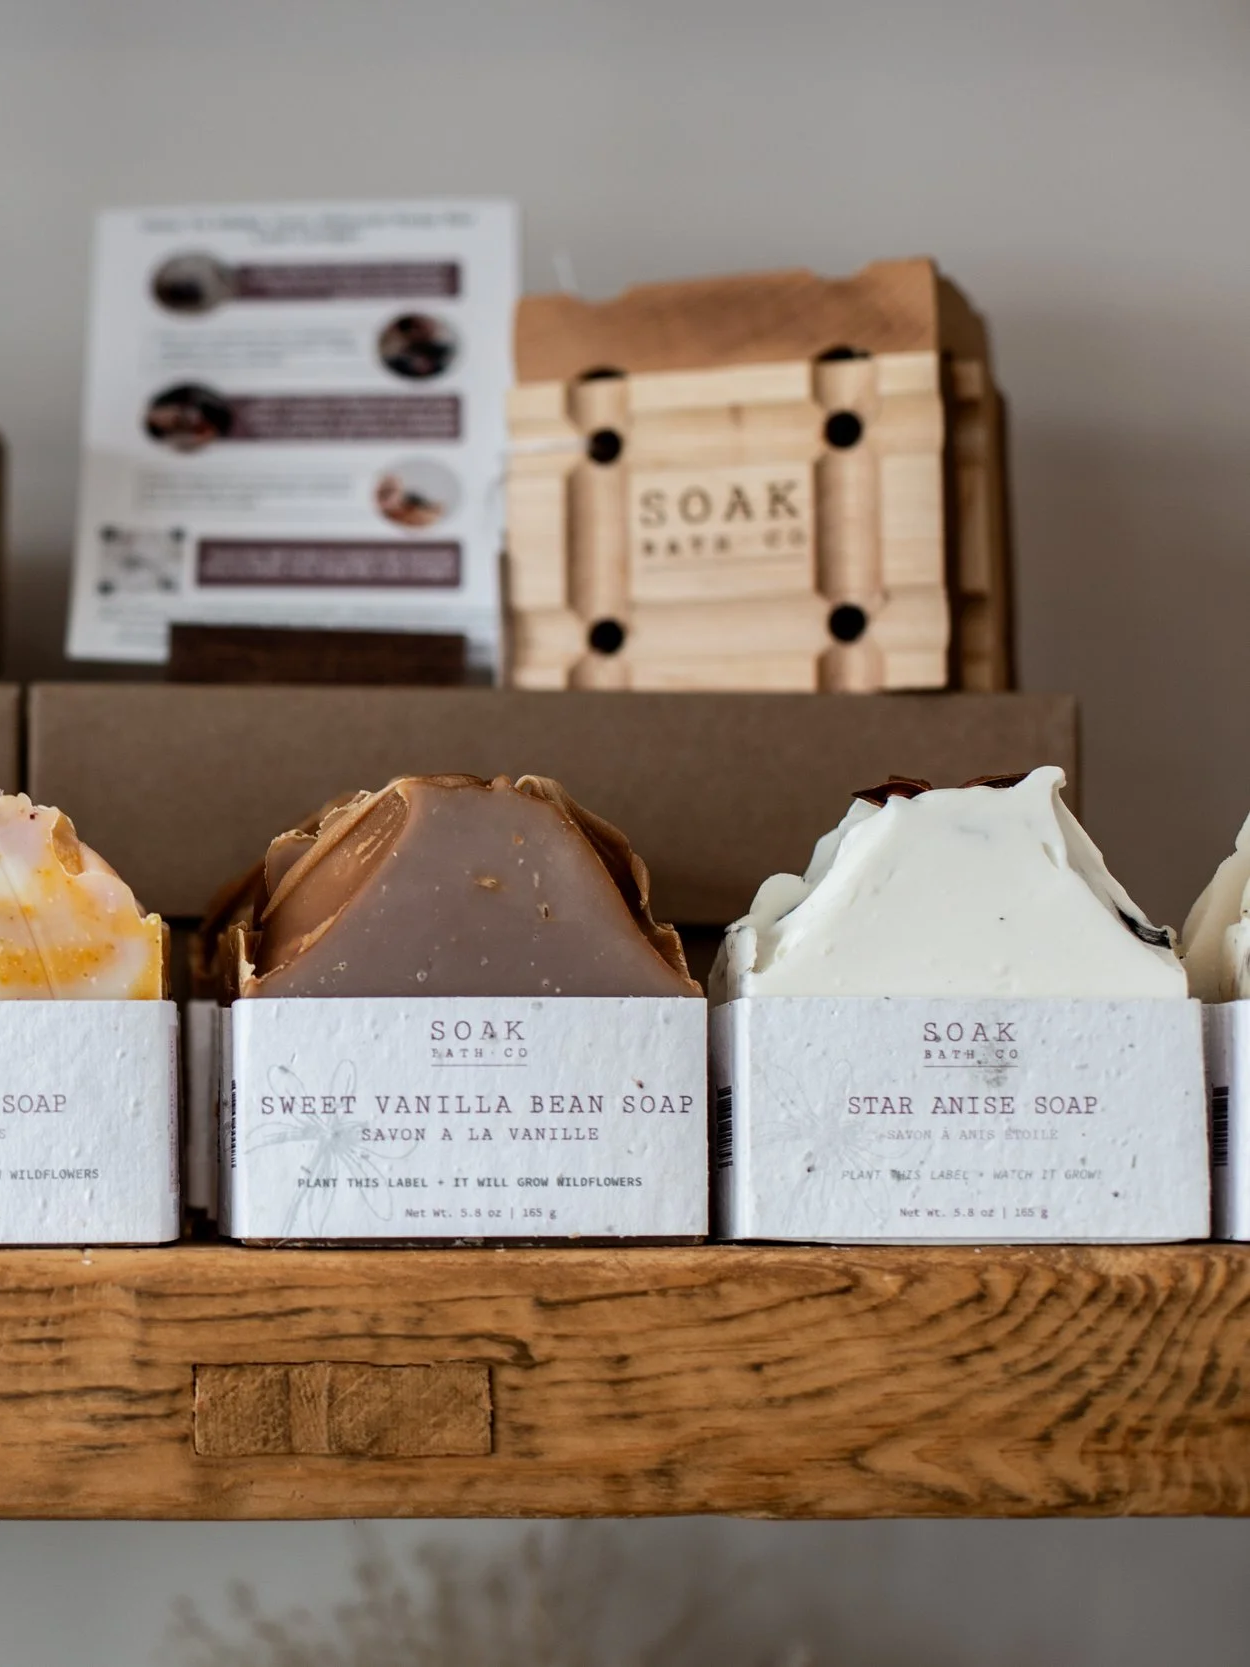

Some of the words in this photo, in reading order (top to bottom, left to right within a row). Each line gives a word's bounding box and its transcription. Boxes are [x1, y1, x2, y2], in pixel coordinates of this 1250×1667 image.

[639, 479, 799, 528] SOAK
[431, 1020, 525, 1041] SOAK
[923, 1022, 1016, 1043] SOAK
[503, 1047, 528, 1058] CO
[924, 1049, 975, 1060] BATH
[995, 1049, 1019, 1060] CO
[2, 1094, 67, 1114] SOAP
[260, 1095, 357, 1114] SWEET
[375, 1095, 513, 1114] VANILLA
[530, 1095, 604, 1114] BEAN
[622, 1095, 694, 1114] SOAP
[848, 1096, 914, 1114] STAR
[930, 1096, 1015, 1114] ANISE
[1034, 1096, 1098, 1114] SOAP
[361, 1127, 426, 1141] SAVON
[468, 1127, 494, 1141] LA
[508, 1127, 599, 1141] VANILLE
[959, 1129, 995, 1140] ANIS
[10, 1168, 100, 1181] WILDFLOWERS
[841, 1170, 882, 1181] PLANT
[930, 1170, 969, 1181] LABEL
[993, 1170, 1033, 1181] WATCH
[1042, 1170, 1057, 1181] IT
[298, 1177, 338, 1189] PLANT
[348, 1177, 380, 1188] THIS
[388, 1177, 429, 1188] LABEL
[453, 1177, 469, 1188] IT
[476, 1177, 509, 1188] WILL
[517, 1176, 549, 1188] GROW
[556, 1176, 643, 1188] WILDFLOWERS
[405, 1208, 426, 1218] Net
[432, 1208, 453, 1218] Wt.
[460, 1208, 482, 1218] 5.8
[488, 1210, 502, 1218] oz
[522, 1208, 543, 1218] 165
[549, 1210, 557, 1220] g
[900, 1208, 920, 1217] Net
[953, 1208, 975, 1217] 5.8
[981, 1209, 995, 1217] oz
[1015, 1207, 1035, 1217] 165
[1040, 1209, 1049, 1219] g
